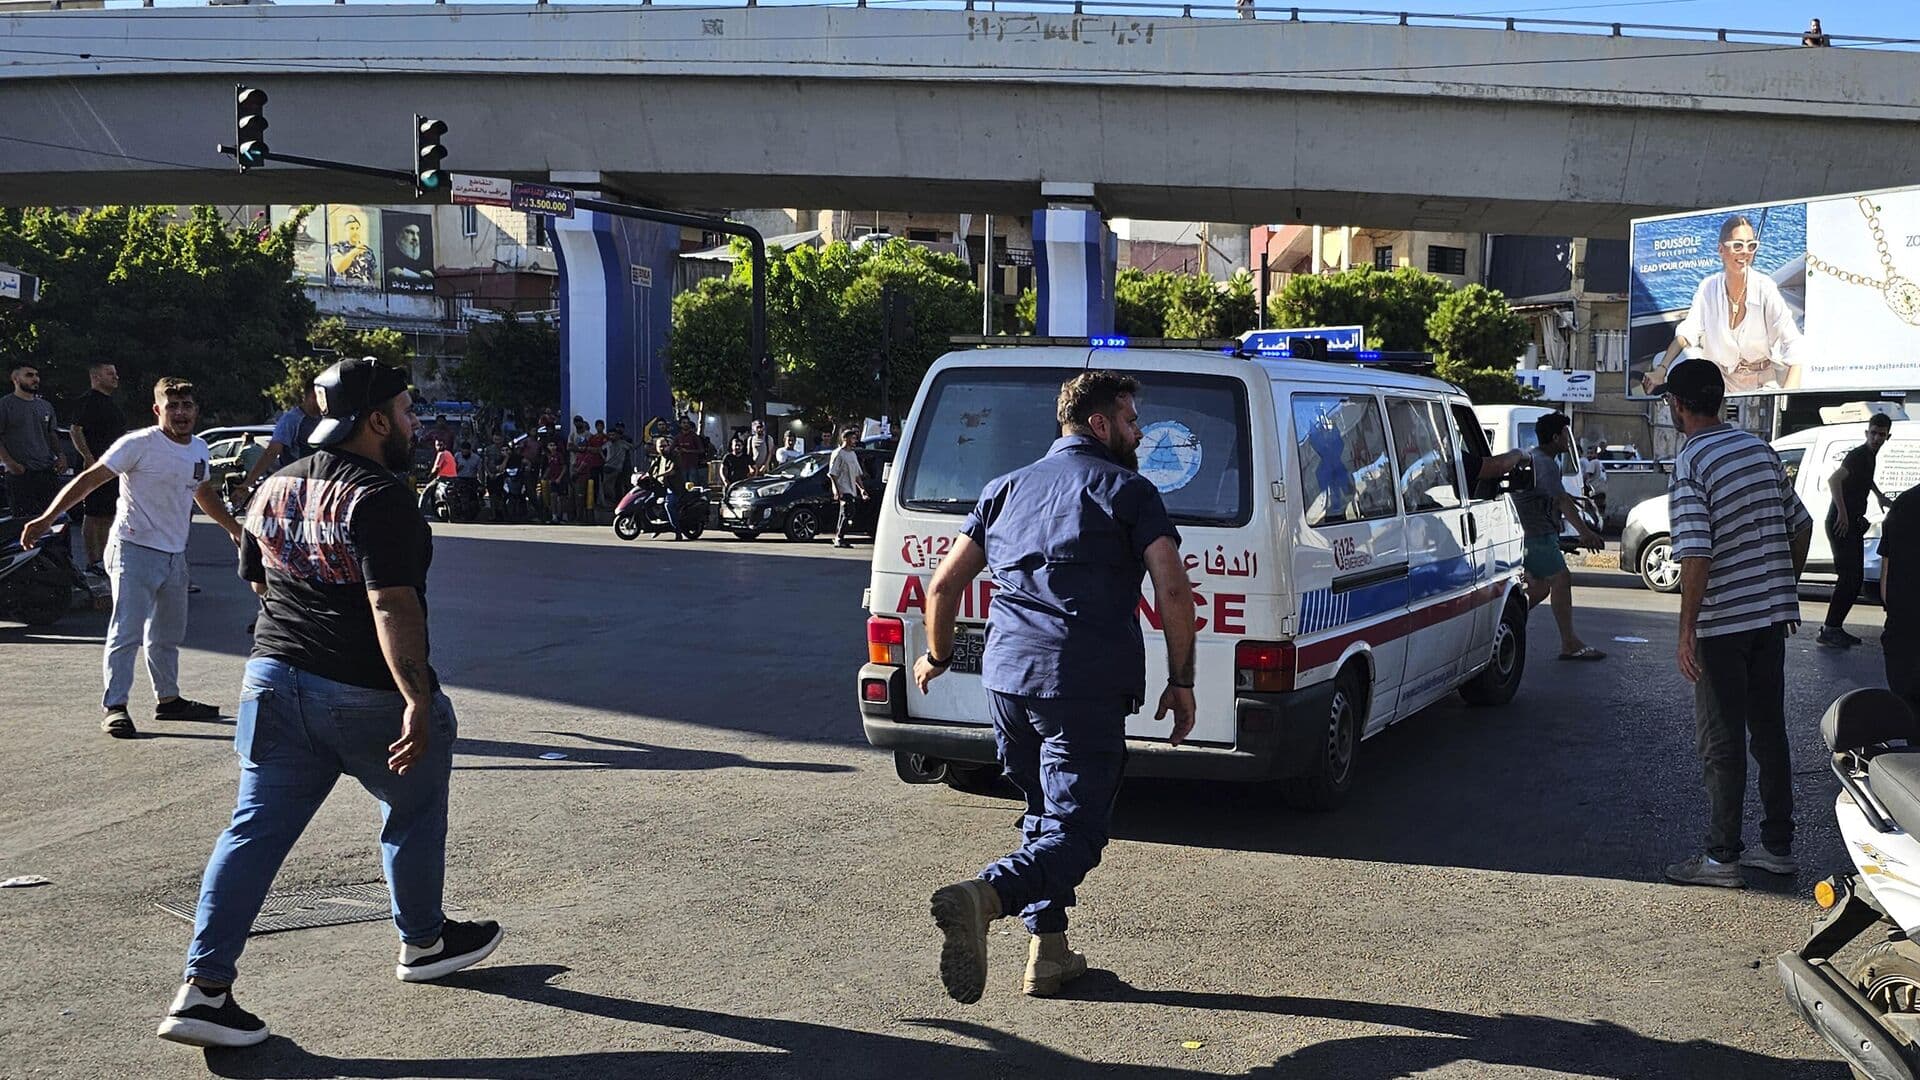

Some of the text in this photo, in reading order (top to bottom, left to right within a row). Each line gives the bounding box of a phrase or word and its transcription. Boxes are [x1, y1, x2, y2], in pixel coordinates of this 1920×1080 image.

[529, 198, 567, 212] 3.500.000
[1654, 236, 1701, 250] BOUSSOLE
[1640, 258, 1714, 273] LEAD YOUR OWN WAY
[922, 536, 957, 555] 12
[1340, 536, 1355, 556] 125
